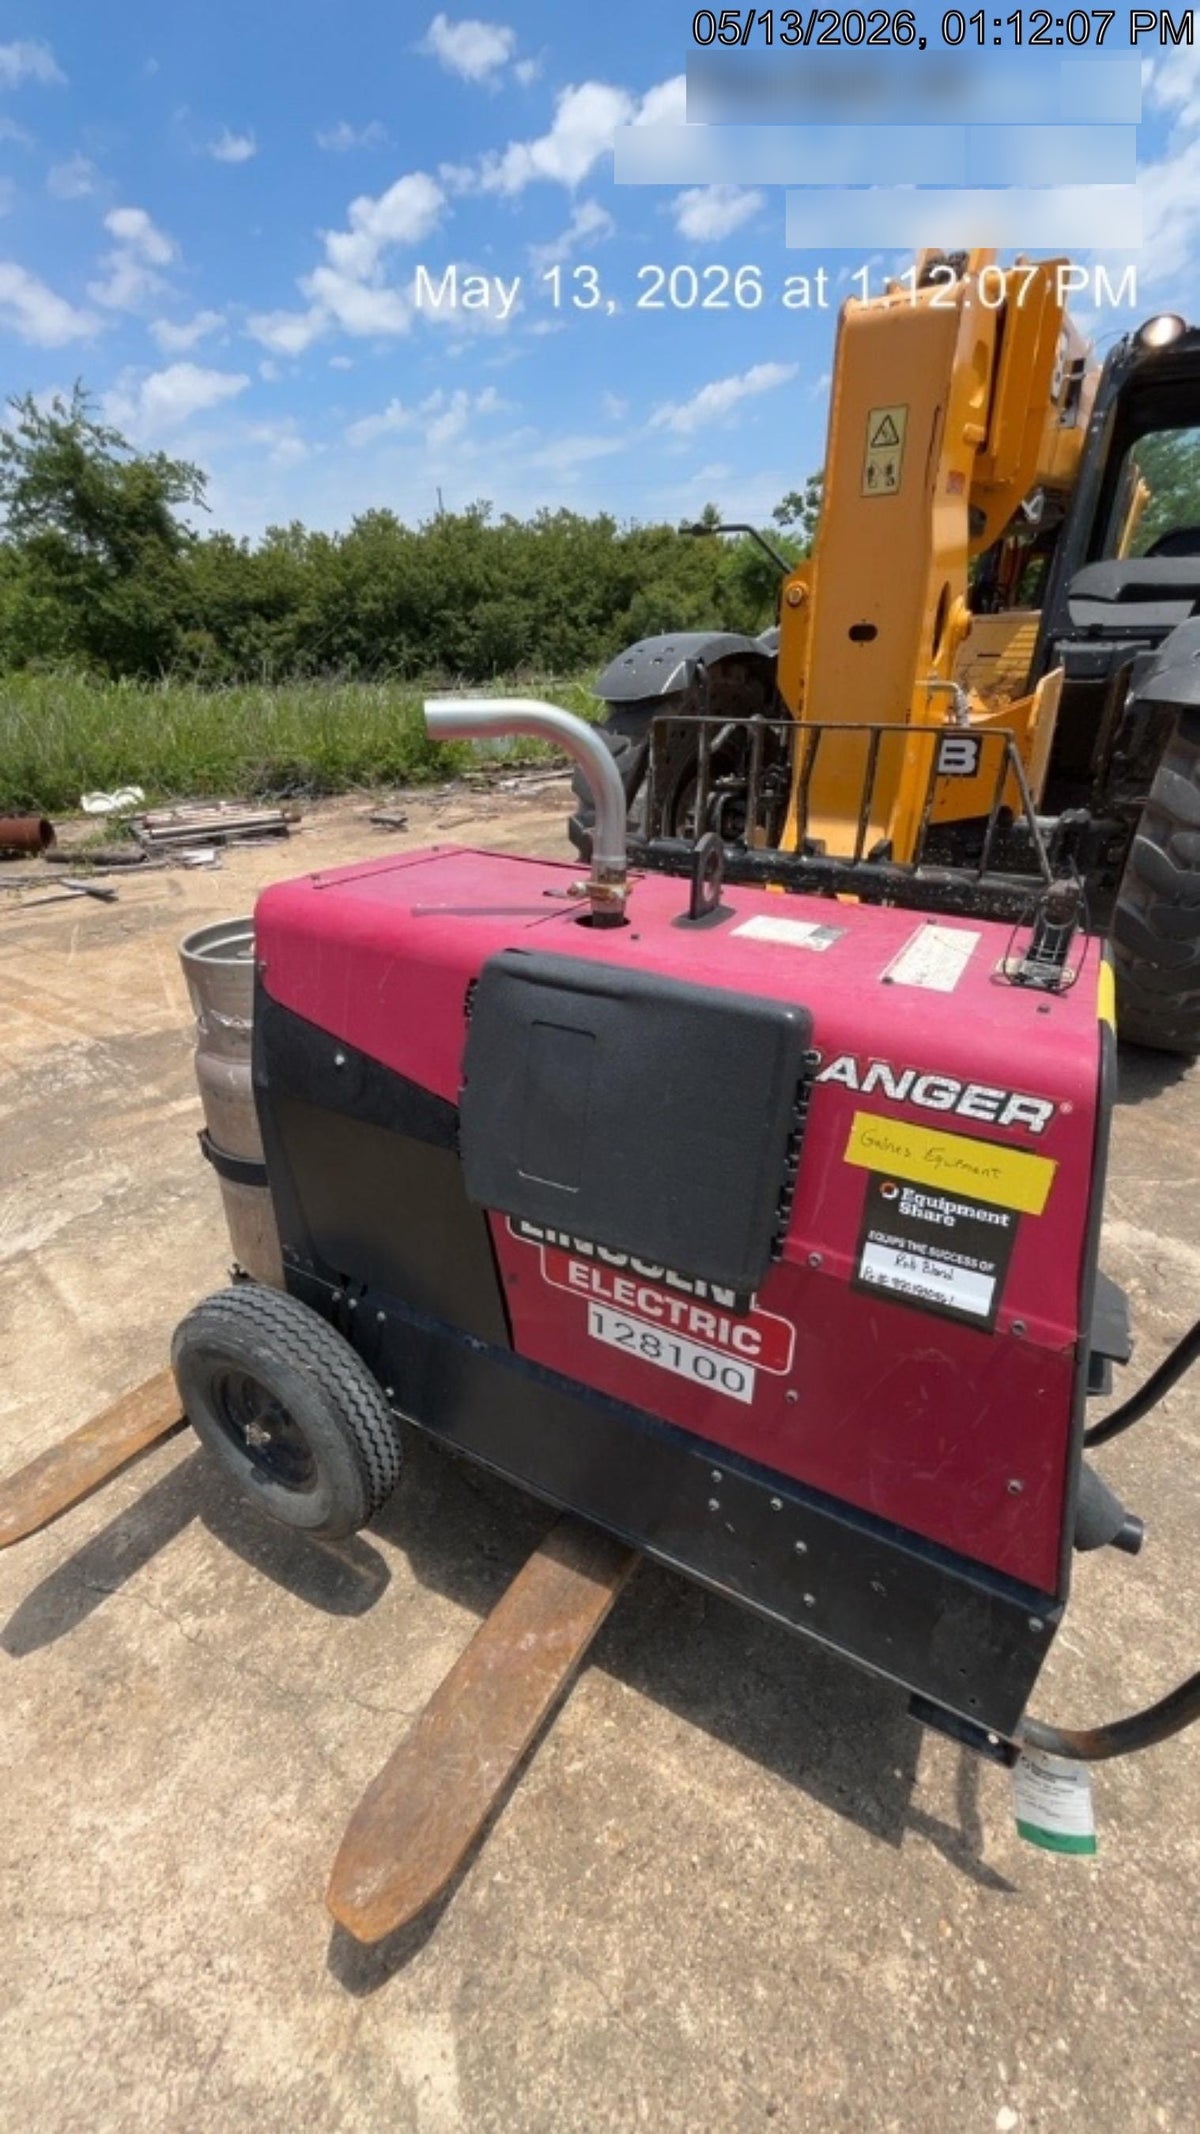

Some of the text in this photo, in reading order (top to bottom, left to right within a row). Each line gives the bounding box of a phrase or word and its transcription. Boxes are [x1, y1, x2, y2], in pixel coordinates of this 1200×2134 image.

[804, 1050, 1054, 1133] ANGER
[899, 1201, 955, 1226] Share
[902, 1187, 1010, 1227] Equipment
[907, 1239, 928, 1256] THE
[928, 1246, 978, 1269] SUCCESS
[979, 1260, 995, 1272] OF
[568, 1260, 762, 1355] ELECTRIC
[593, 1311, 746, 1393] 128100
